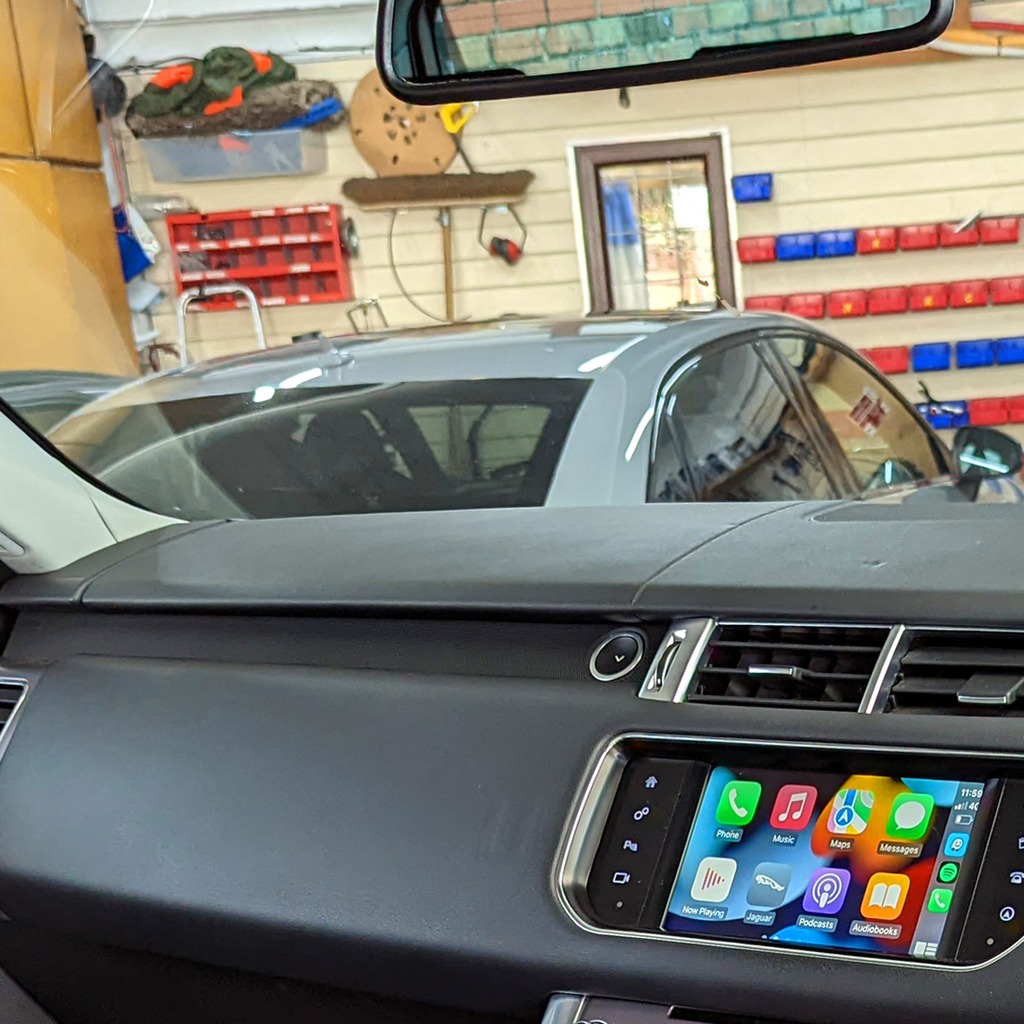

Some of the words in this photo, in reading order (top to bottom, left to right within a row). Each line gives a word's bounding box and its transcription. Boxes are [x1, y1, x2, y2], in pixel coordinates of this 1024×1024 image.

[961, 788, 983, 798] 11:59
[716, 829, 740, 840] Phone
[772, 834, 795, 844] Music
[830, 839, 852, 850] Maps
[879, 843, 920, 856] Messages
[682, 905, 698, 915] Now
[698, 906, 725, 919] Playing
[746, 912, 772, 923] Jaguar
[798, 917, 834, 929] Podcasts
[852, 923, 898, 936] Audiobooks
